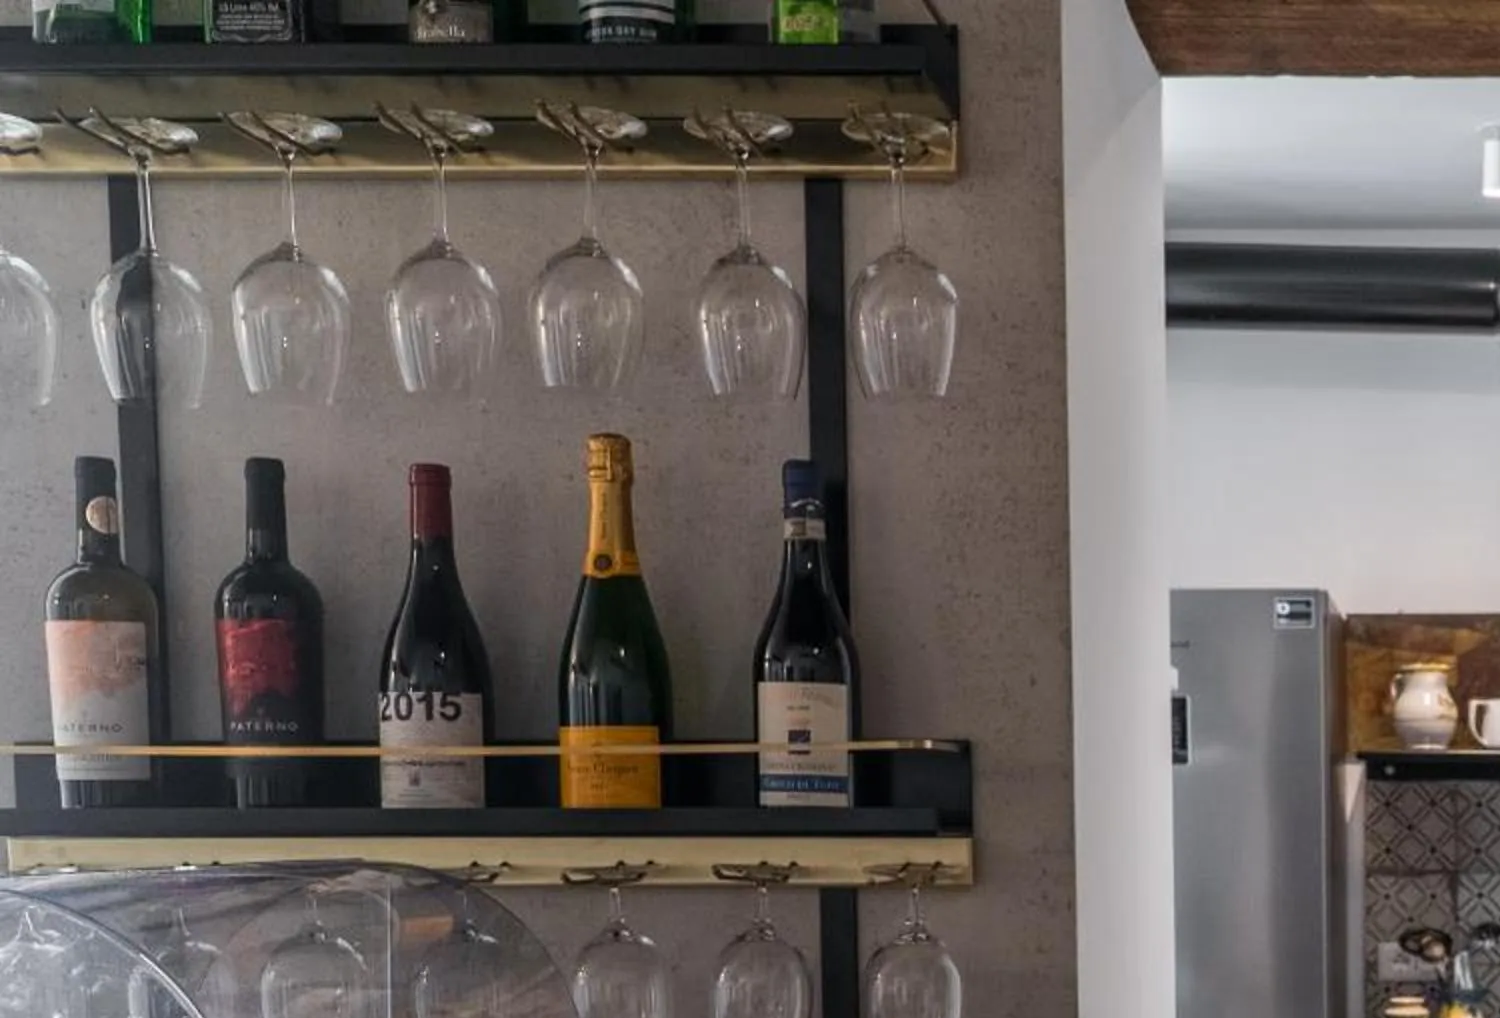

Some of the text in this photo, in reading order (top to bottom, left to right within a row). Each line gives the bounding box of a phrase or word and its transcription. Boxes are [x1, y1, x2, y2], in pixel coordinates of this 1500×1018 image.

[381, 690, 462, 721] 2015
[58, 723, 123, 733] ATERNO
[230, 721, 299, 732] PATERNO
